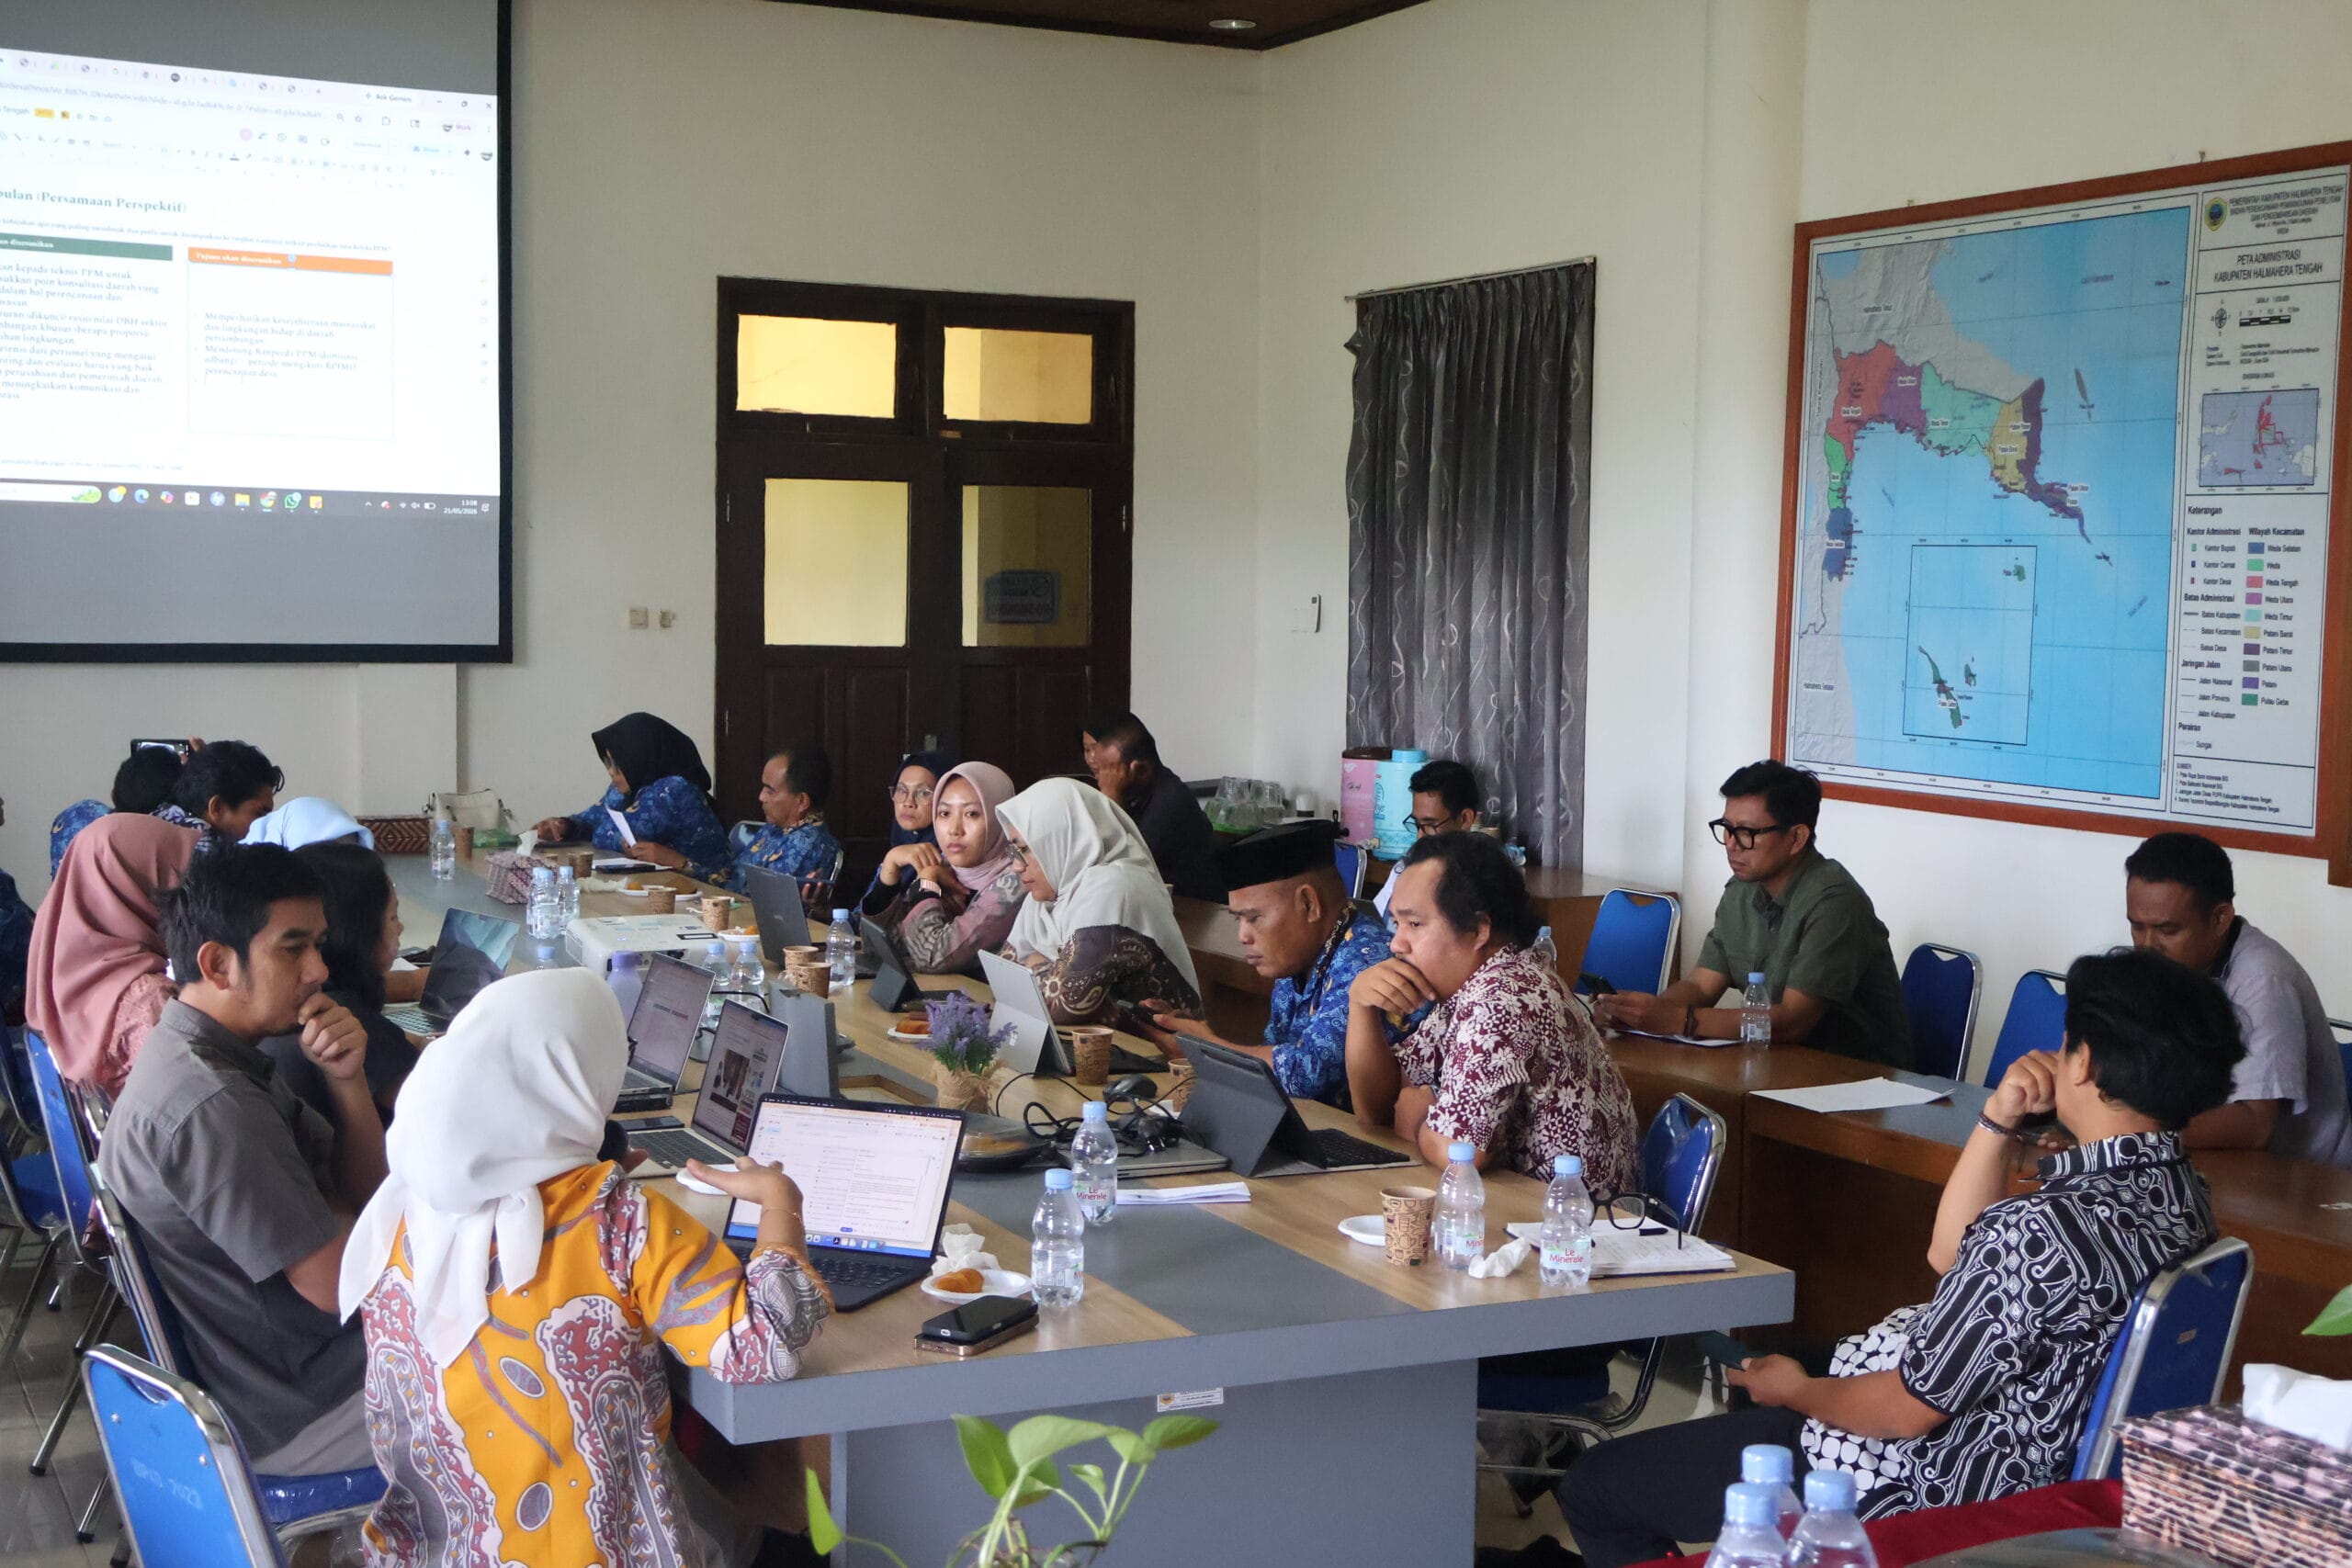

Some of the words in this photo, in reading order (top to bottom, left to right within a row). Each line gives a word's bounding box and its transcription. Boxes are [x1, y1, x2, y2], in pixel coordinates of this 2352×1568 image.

[2236, 254, 2255, 265] PETA
[2254, 249, 2301, 265] ADMINISTRASI
[2213, 269, 2252, 283] KABUPATEN
[2252, 265, 2294, 279] HALMAHERA
[2294, 262, 2324, 275] TENGAH
[2188, 505, 2222, 516] Keterangan
[2187, 527, 2204, 536] Kantor
[2206, 527, 2241, 536] Administrasi
[2248, 527, 2271, 537] Wilayah
[2272, 527, 2305, 536] Kecamatan
[2181, 660, 2205, 670] Jaringan
[2206, 660, 2221, 669] Jalan
[2178, 722, 2201, 732] Perairan
[1089, 1186, 1099, 1194] Le
[1076, 1190, 1107, 1201] Minerale
[1565, 1247, 1575, 1257] Le
[1549, 1254, 1584, 1264] Minerale
